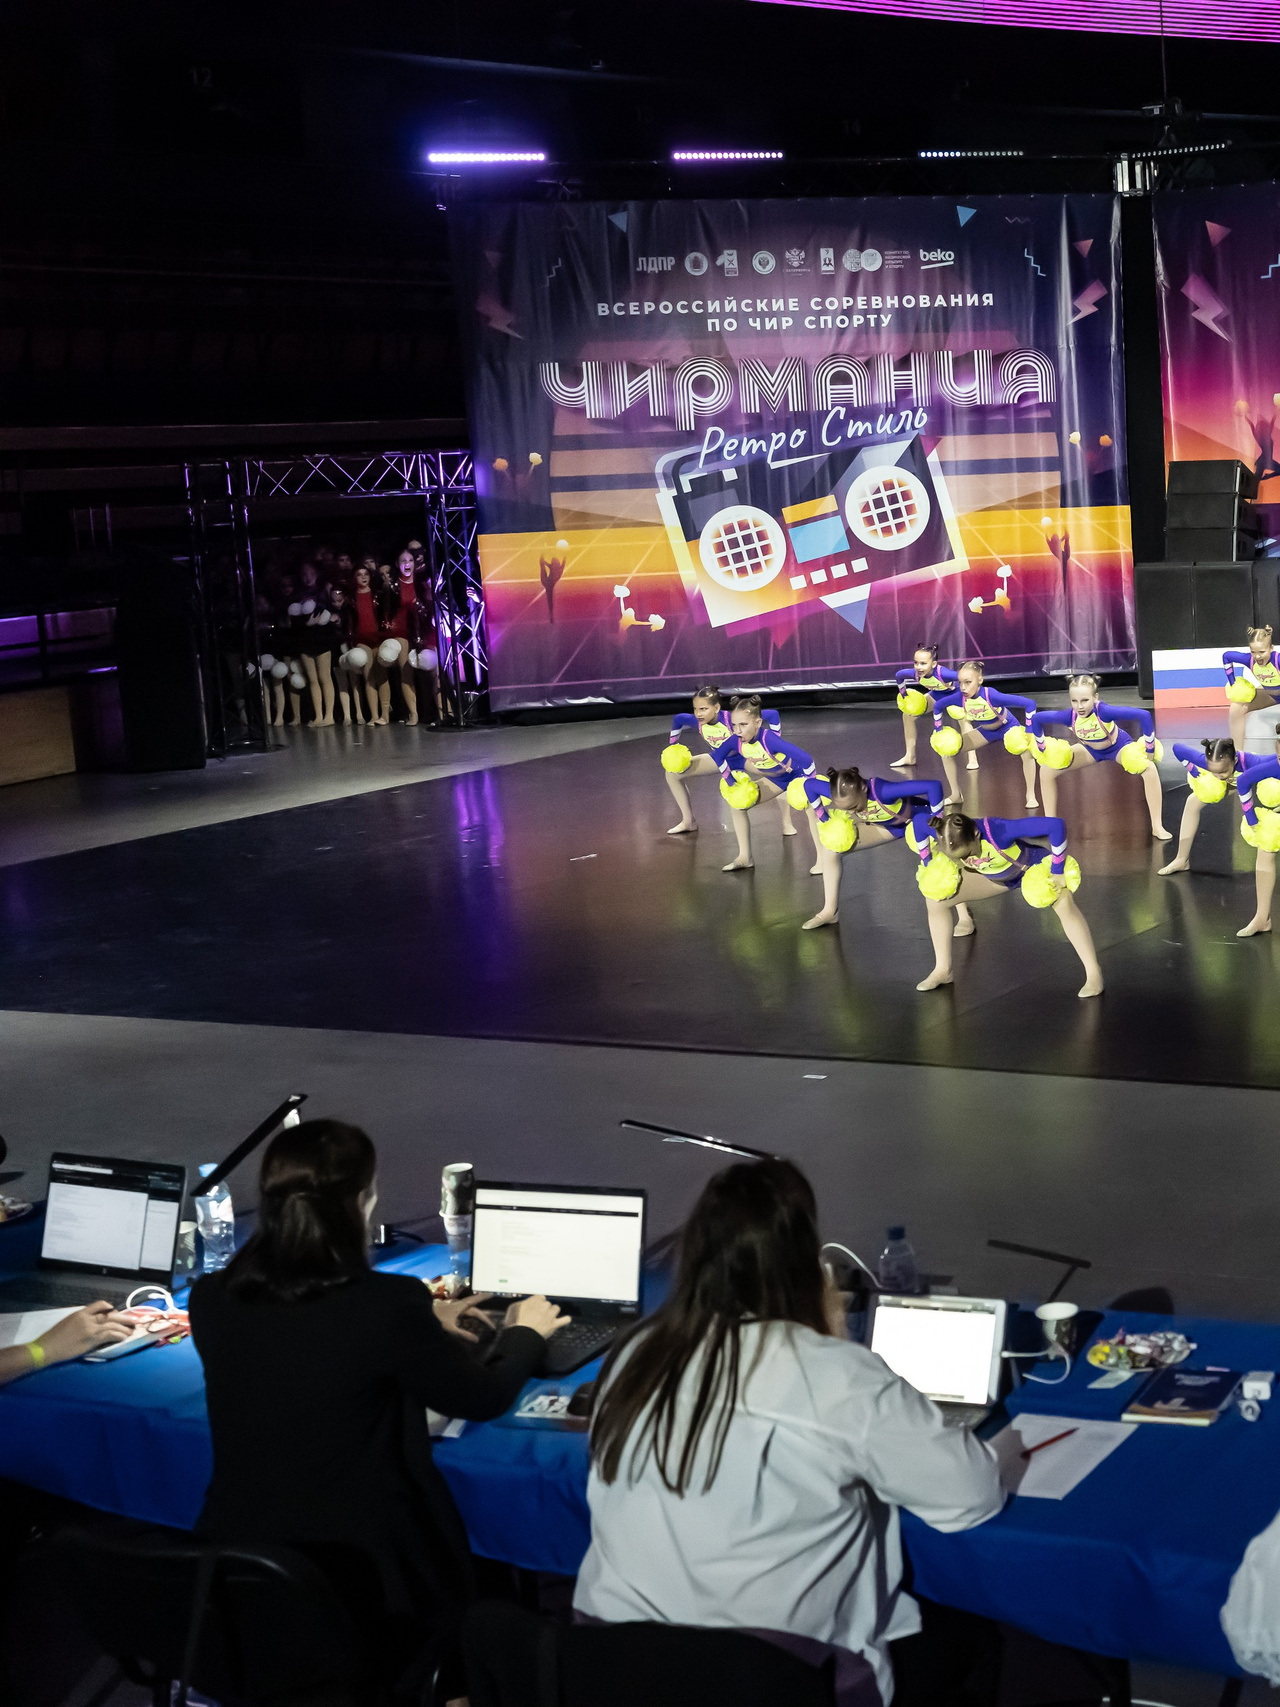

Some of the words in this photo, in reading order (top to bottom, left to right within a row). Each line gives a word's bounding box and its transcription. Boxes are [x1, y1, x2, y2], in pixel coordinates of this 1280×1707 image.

[919, 248, 955, 262] beko
[636, 256, 676, 274] ЛДПР
[597, 297, 800, 316] ВСЕРОССИЙСКИЕ
[810, 293, 994, 311] СОРЕВНОВАНИЯ
[707, 317, 738, 332] ПО
[748, 317, 794, 331] ЧИР
[804, 313, 893, 330] СПОРТУ
[698, 426, 807, 469] Ретро
[821, 406, 928, 447] Стиль
